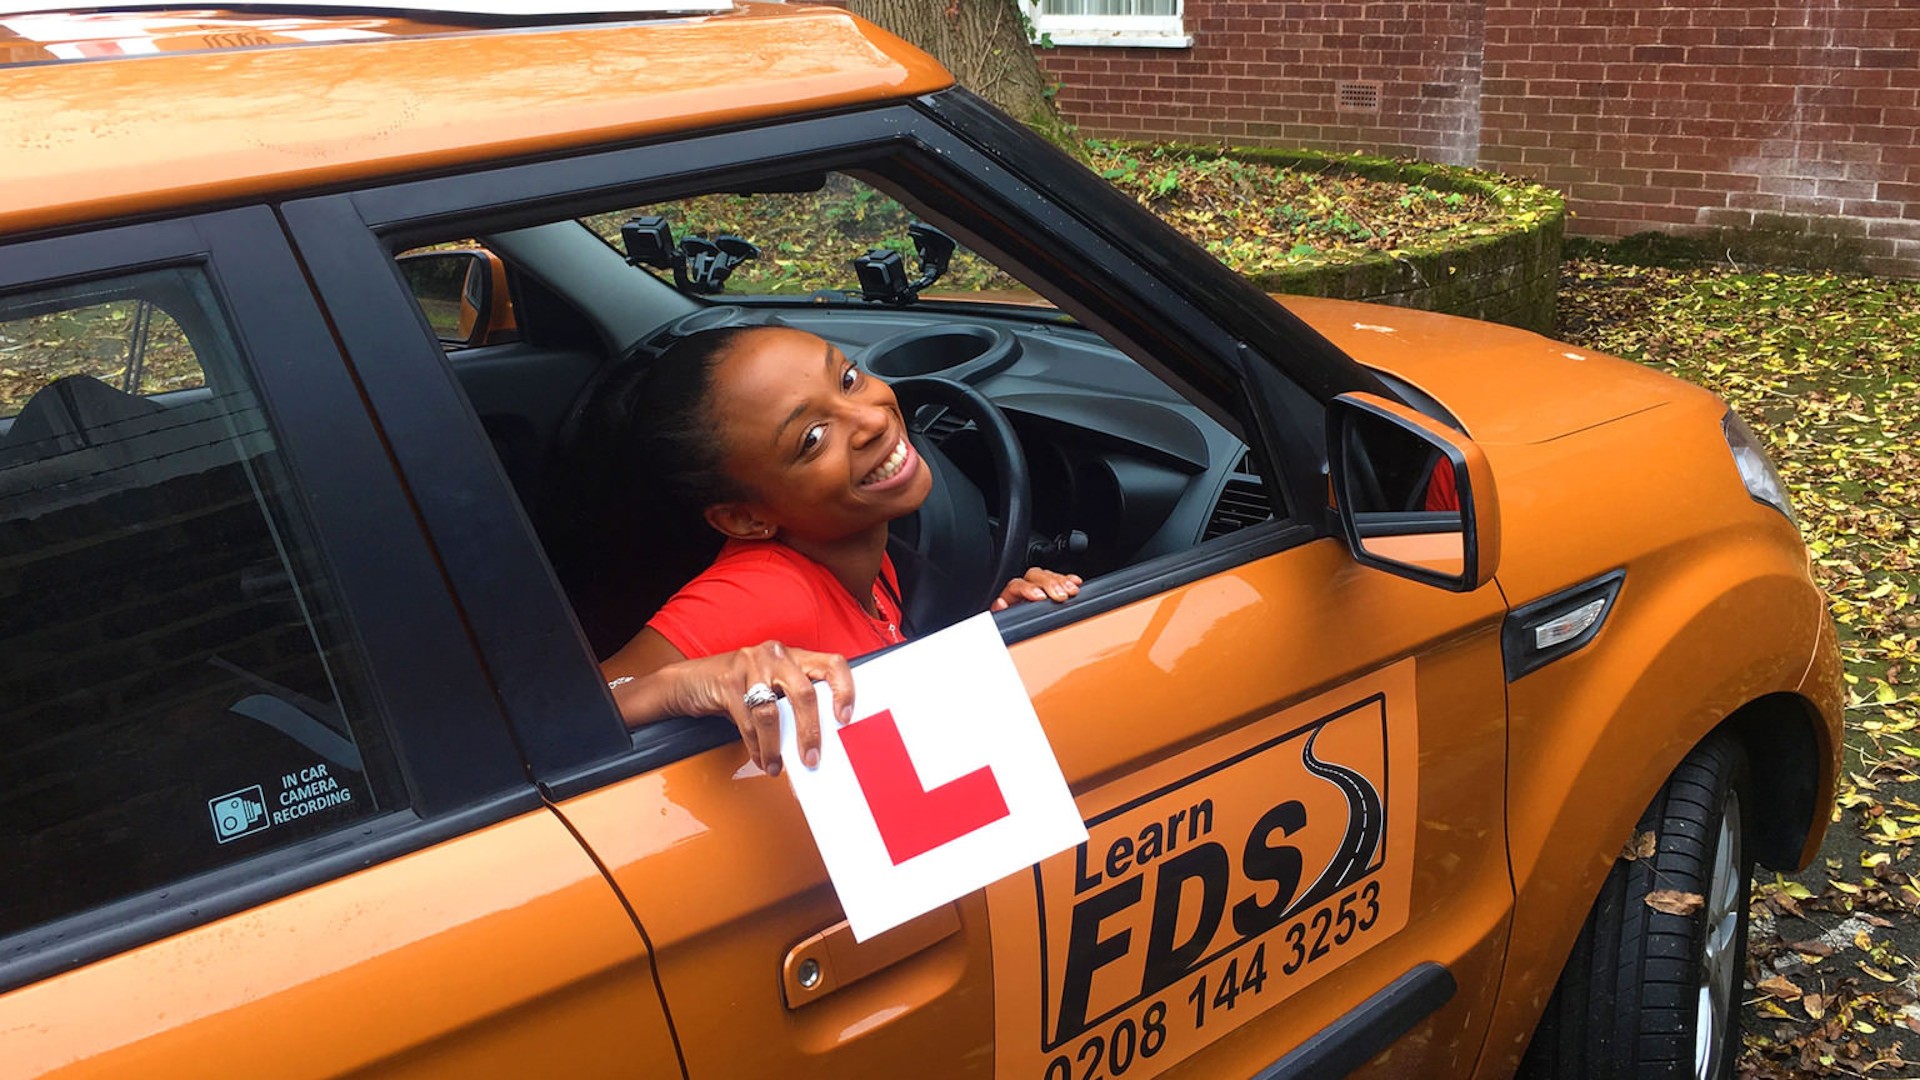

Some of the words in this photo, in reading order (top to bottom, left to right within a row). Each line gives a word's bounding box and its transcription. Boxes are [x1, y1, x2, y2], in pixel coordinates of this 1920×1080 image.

[273, 788, 351, 825] RECORDING
[280, 777, 338, 806] CAMERA
[282, 773, 299, 788] IN
[300, 764, 328, 783] CAR
[837, 708, 1010, 866] L
[1074, 798, 1214, 896] Learn
[1056, 800, 1307, 1042] FDS
[1188, 942, 1267, 1028] 144
[1282, 881, 1380, 976] 3253
